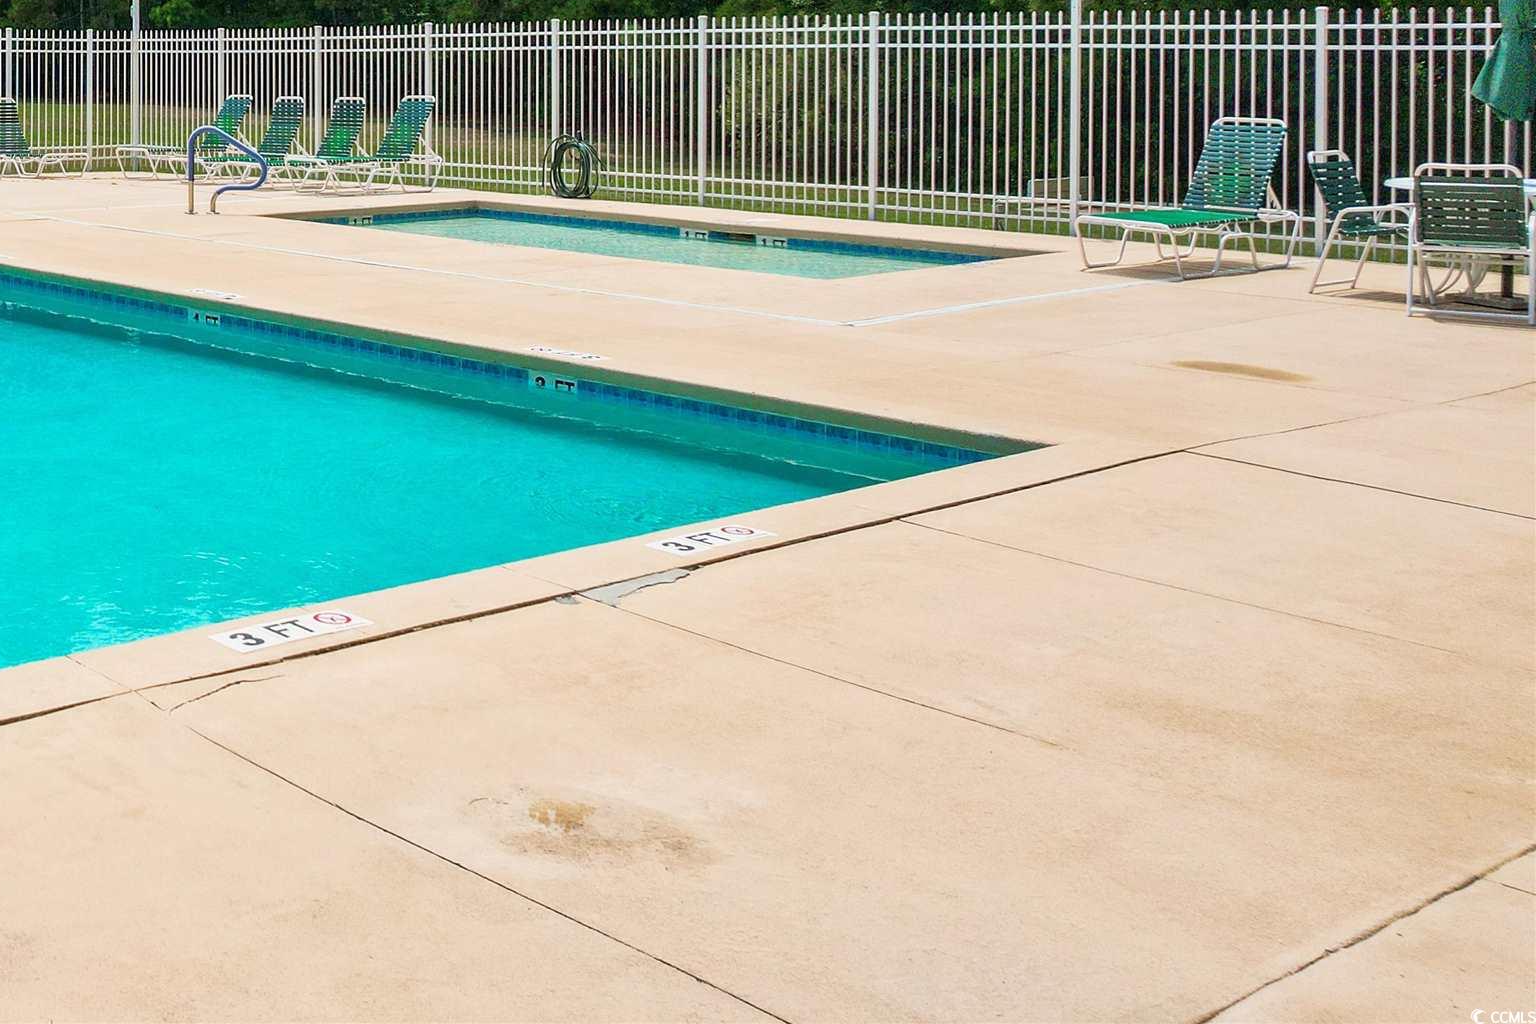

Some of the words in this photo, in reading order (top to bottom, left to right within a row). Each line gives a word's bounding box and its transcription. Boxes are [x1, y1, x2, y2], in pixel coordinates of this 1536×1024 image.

[662, 541, 696, 552] 3
[685, 532, 731, 546] FT
[229, 632, 265, 646] 3
[264, 619, 315, 639] FT
